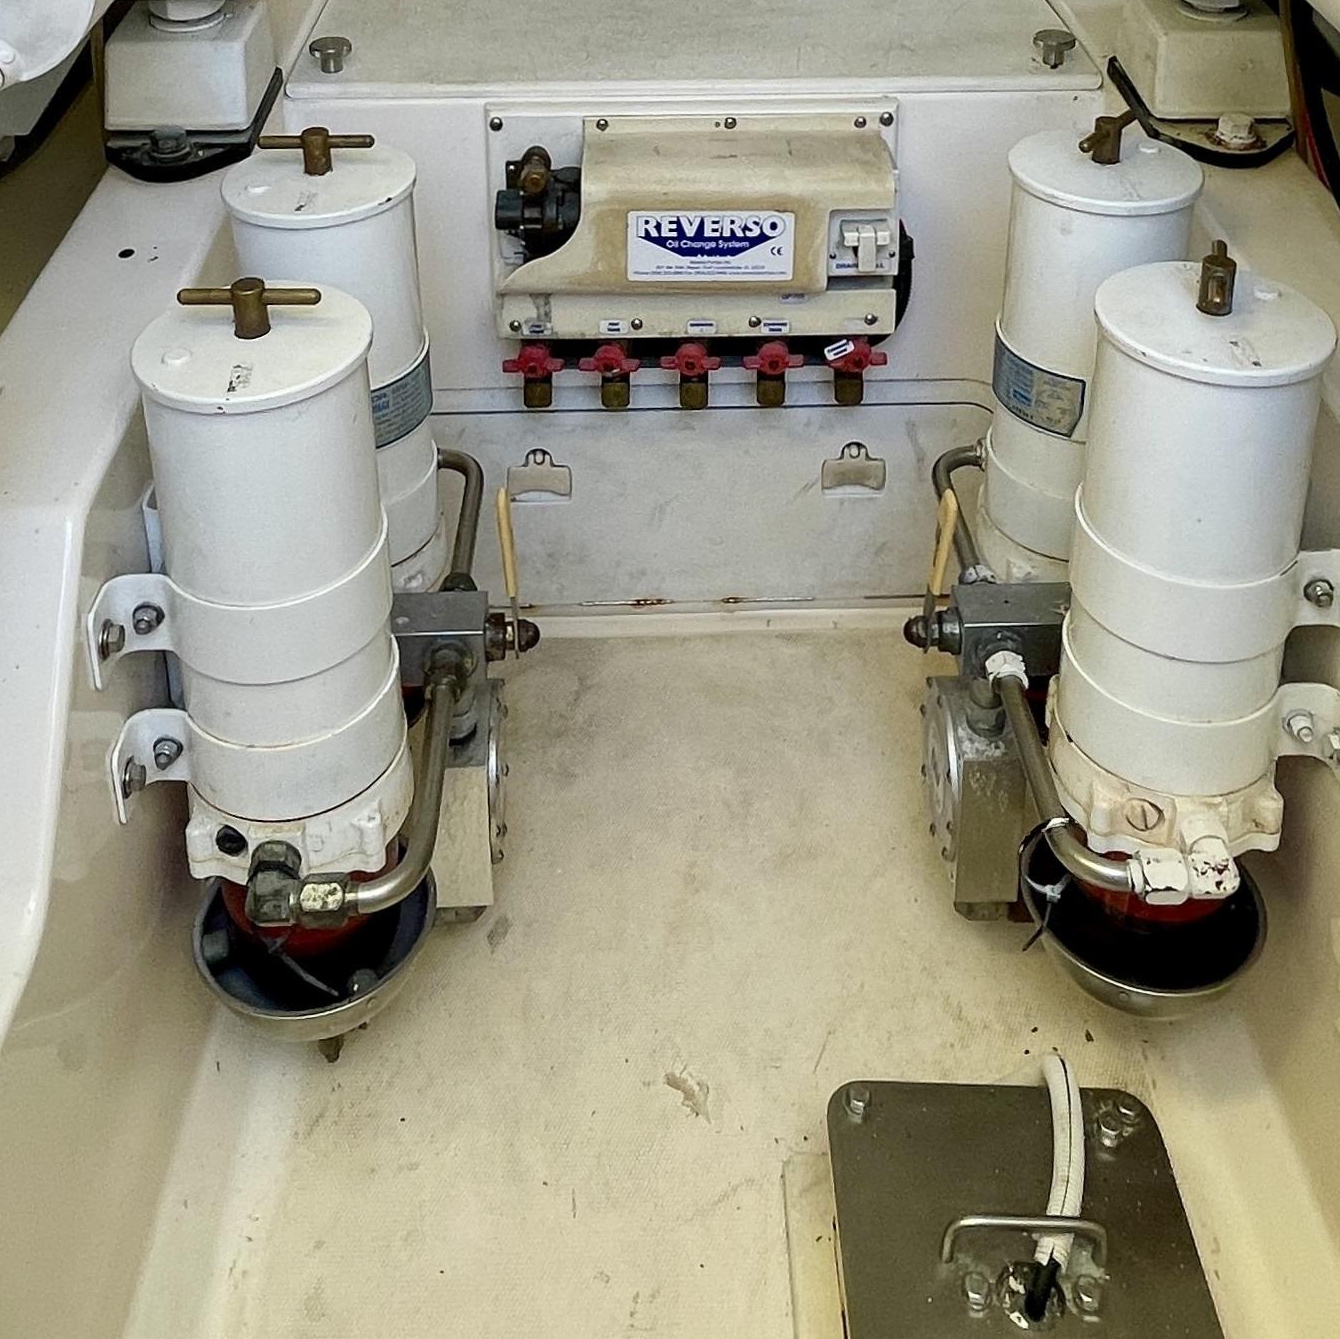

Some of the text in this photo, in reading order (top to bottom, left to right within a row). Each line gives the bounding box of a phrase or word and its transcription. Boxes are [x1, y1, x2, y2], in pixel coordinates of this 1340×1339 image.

[637, 215, 786, 238] REVERSO
[666, 239, 750, 250] Oil Change System
